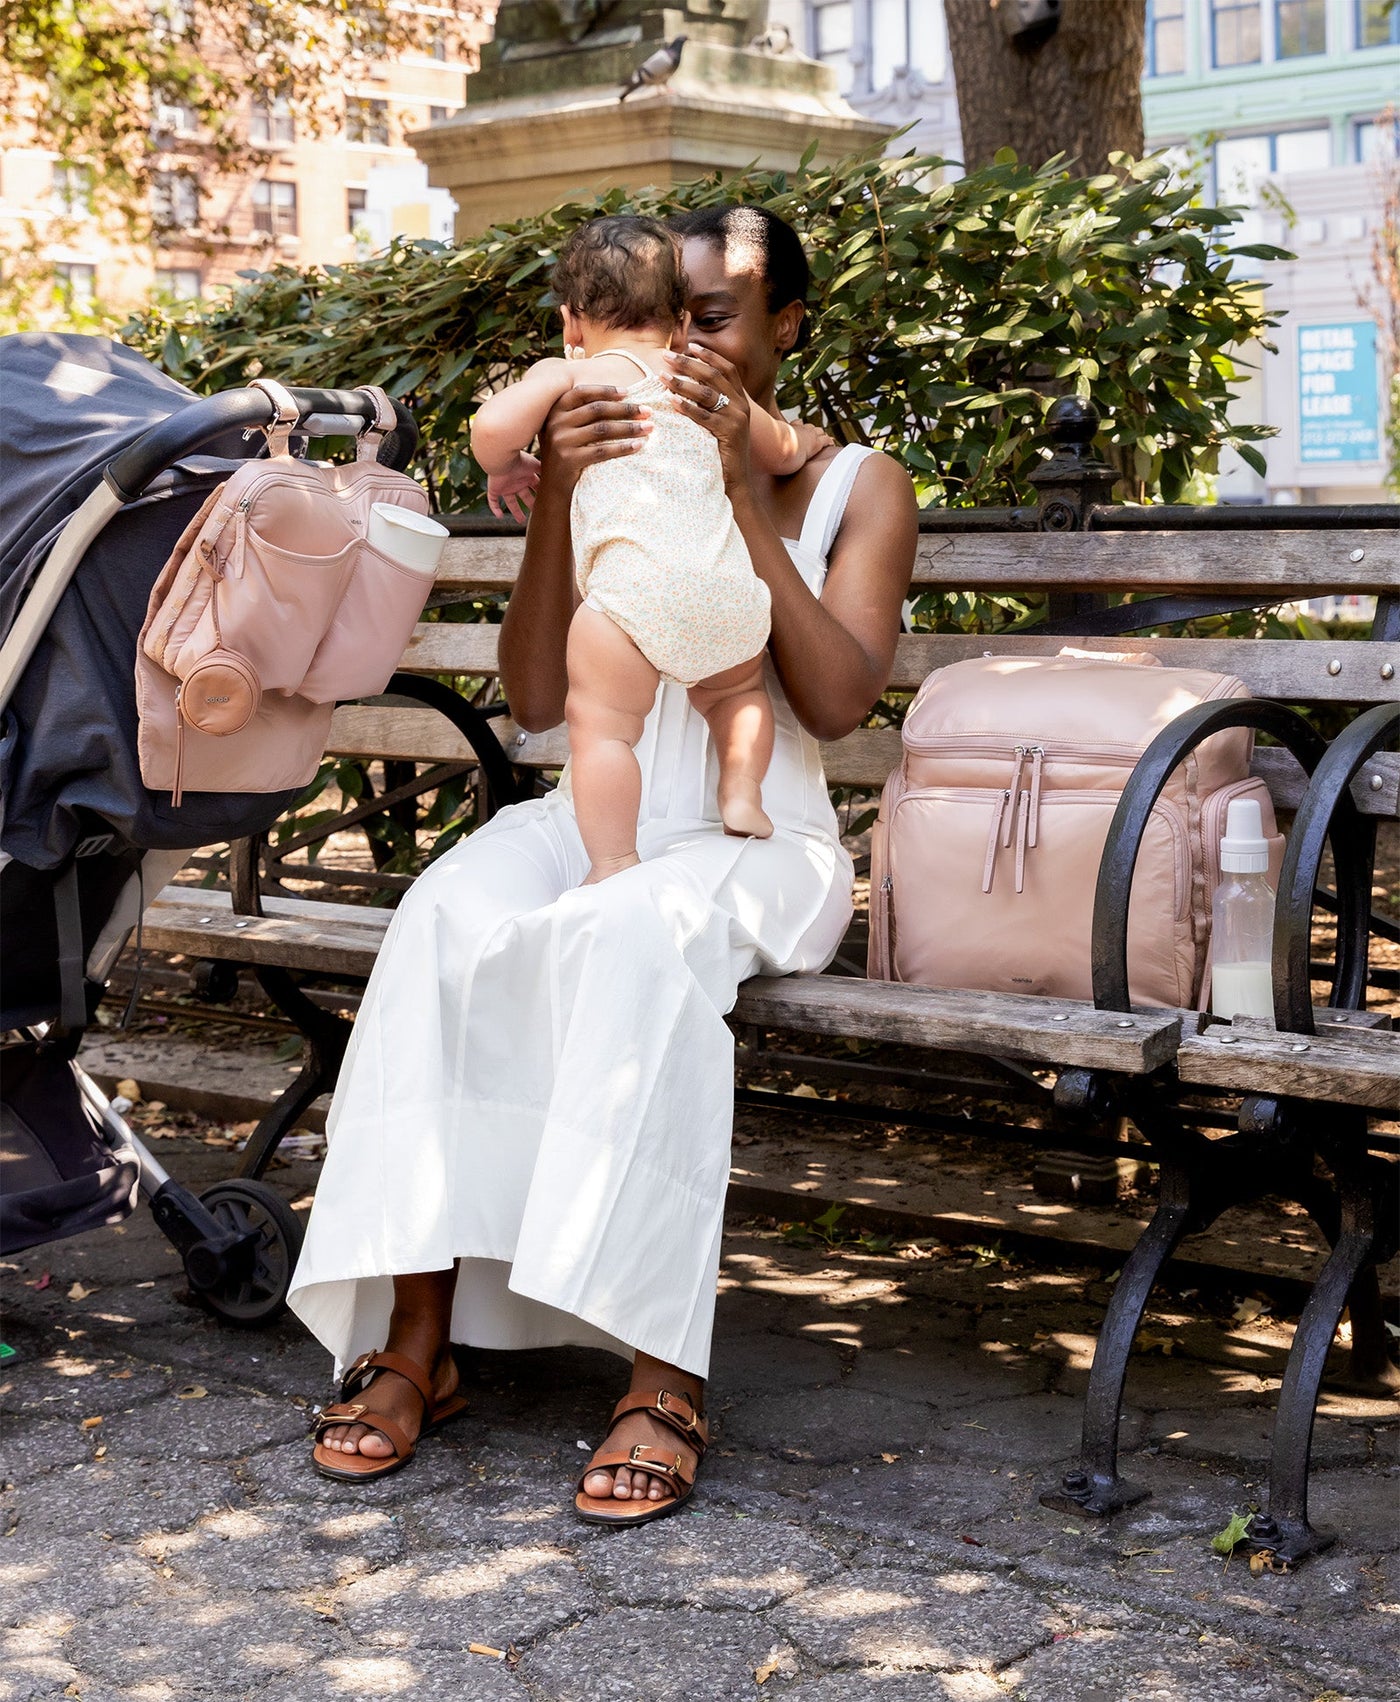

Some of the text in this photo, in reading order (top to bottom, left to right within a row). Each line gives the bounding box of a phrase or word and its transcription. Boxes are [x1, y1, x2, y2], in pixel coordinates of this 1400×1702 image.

[1301, 328, 1357, 350] RETAIL
[1301, 350, 1354, 372] SPACE
[1302, 373, 1336, 394] FOR
[1302, 395, 1352, 416] LEASE
